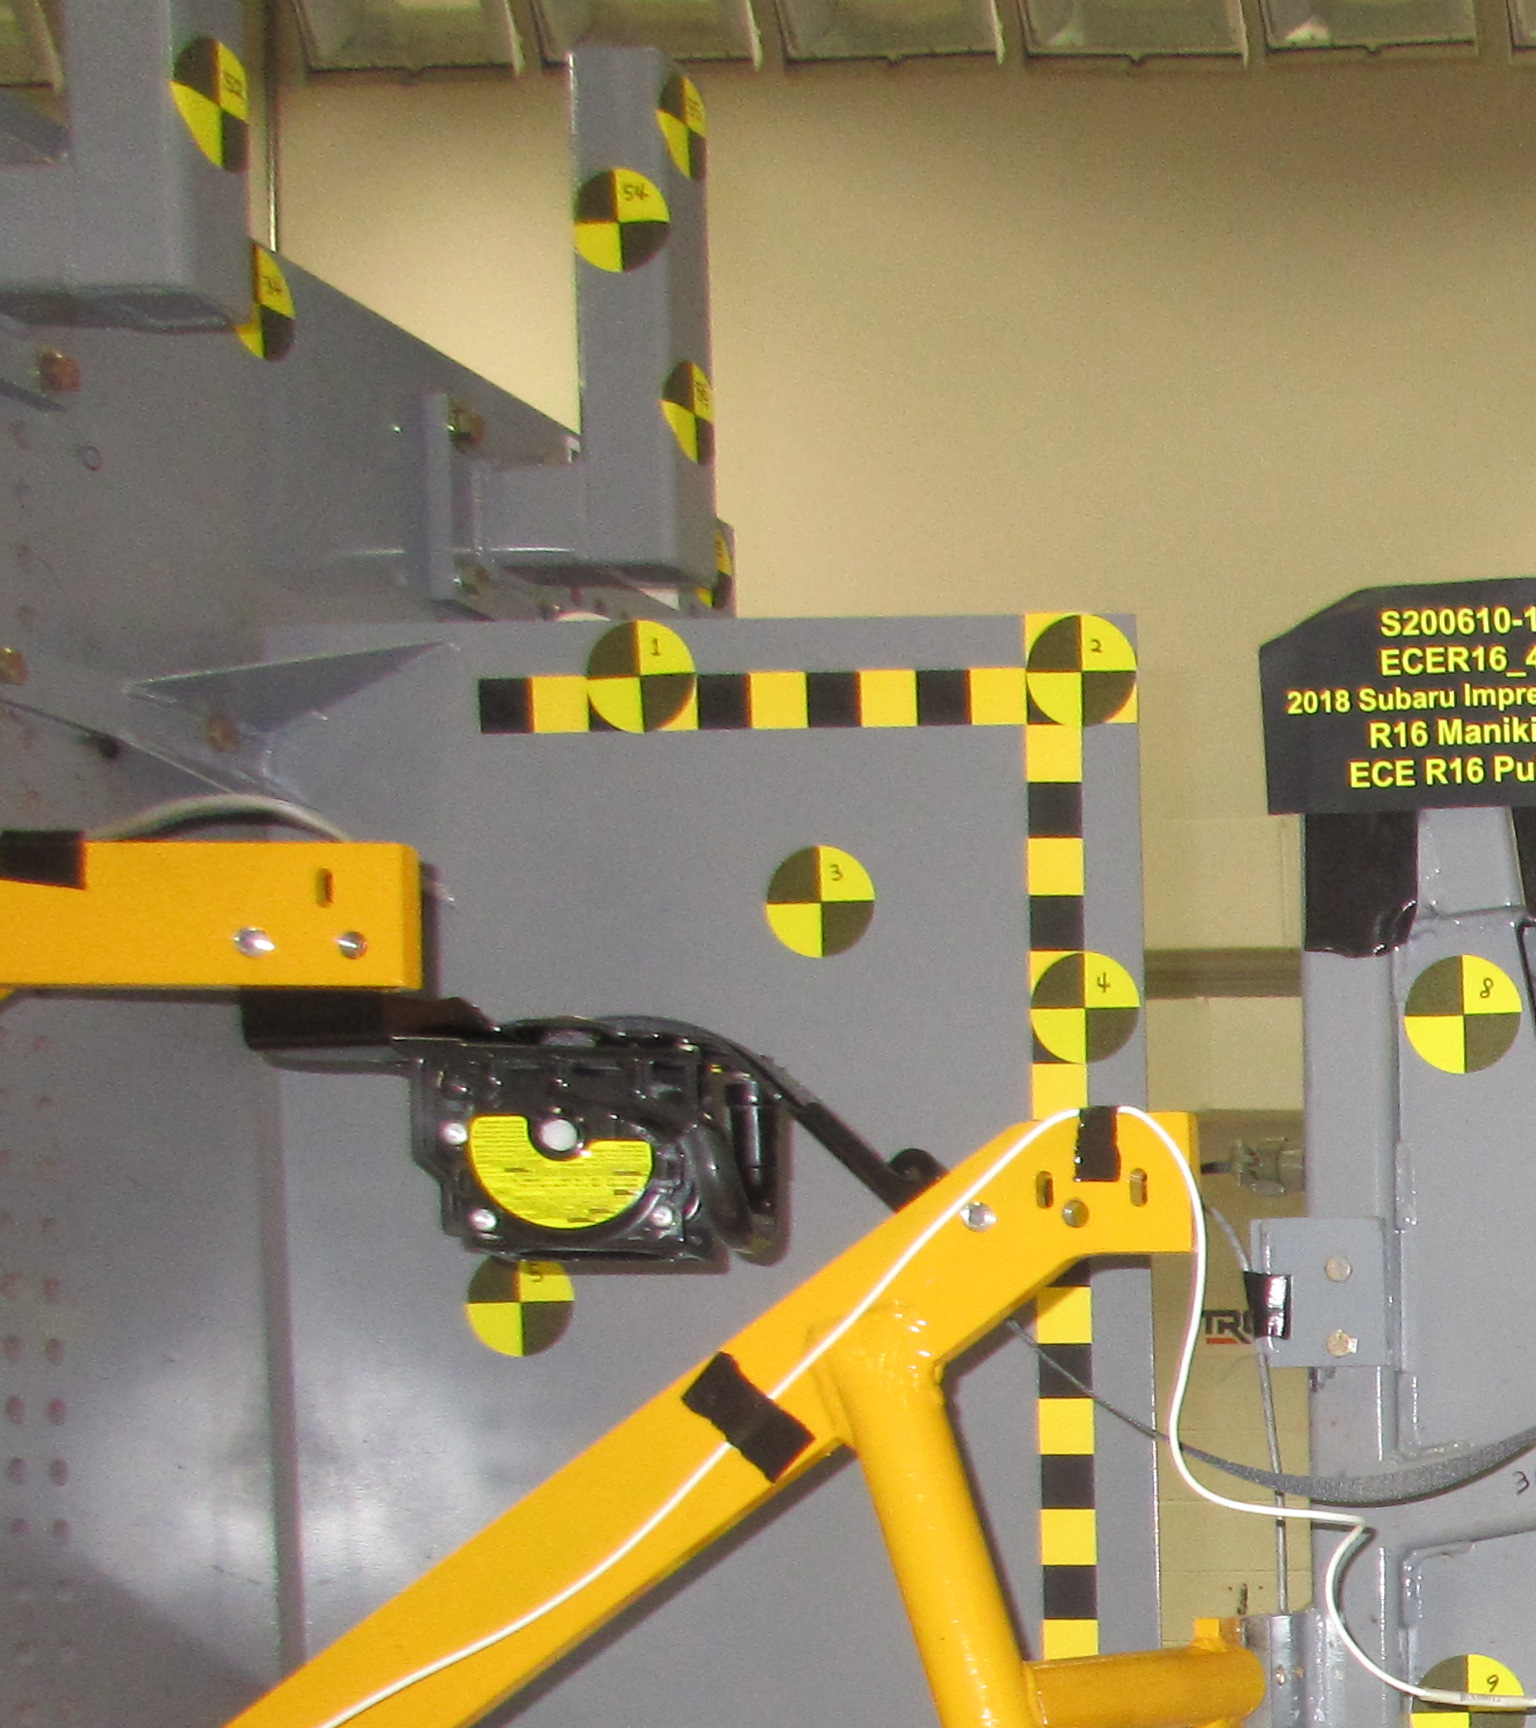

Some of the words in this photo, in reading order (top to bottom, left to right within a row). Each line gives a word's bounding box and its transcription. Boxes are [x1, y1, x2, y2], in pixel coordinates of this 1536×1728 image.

[624, 183, 649, 201] 54
[652, 637, 660, 657] 1
[1091, 638, 1102, 654] 2
[1287, 690, 1351, 715] 2018
[1358, 686, 1456, 712] Subaru
[1370, 720, 1429, 749] R16
[1350, 760, 1416, 788] ECE
[1426, 757, 1484, 785] R16
[831, 863, 843, 882] 3
[1096, 971, 1111, 994] 4
[1480, 977, 1495, 1000] 8
[1487, 1674, 1500, 1693] 9
